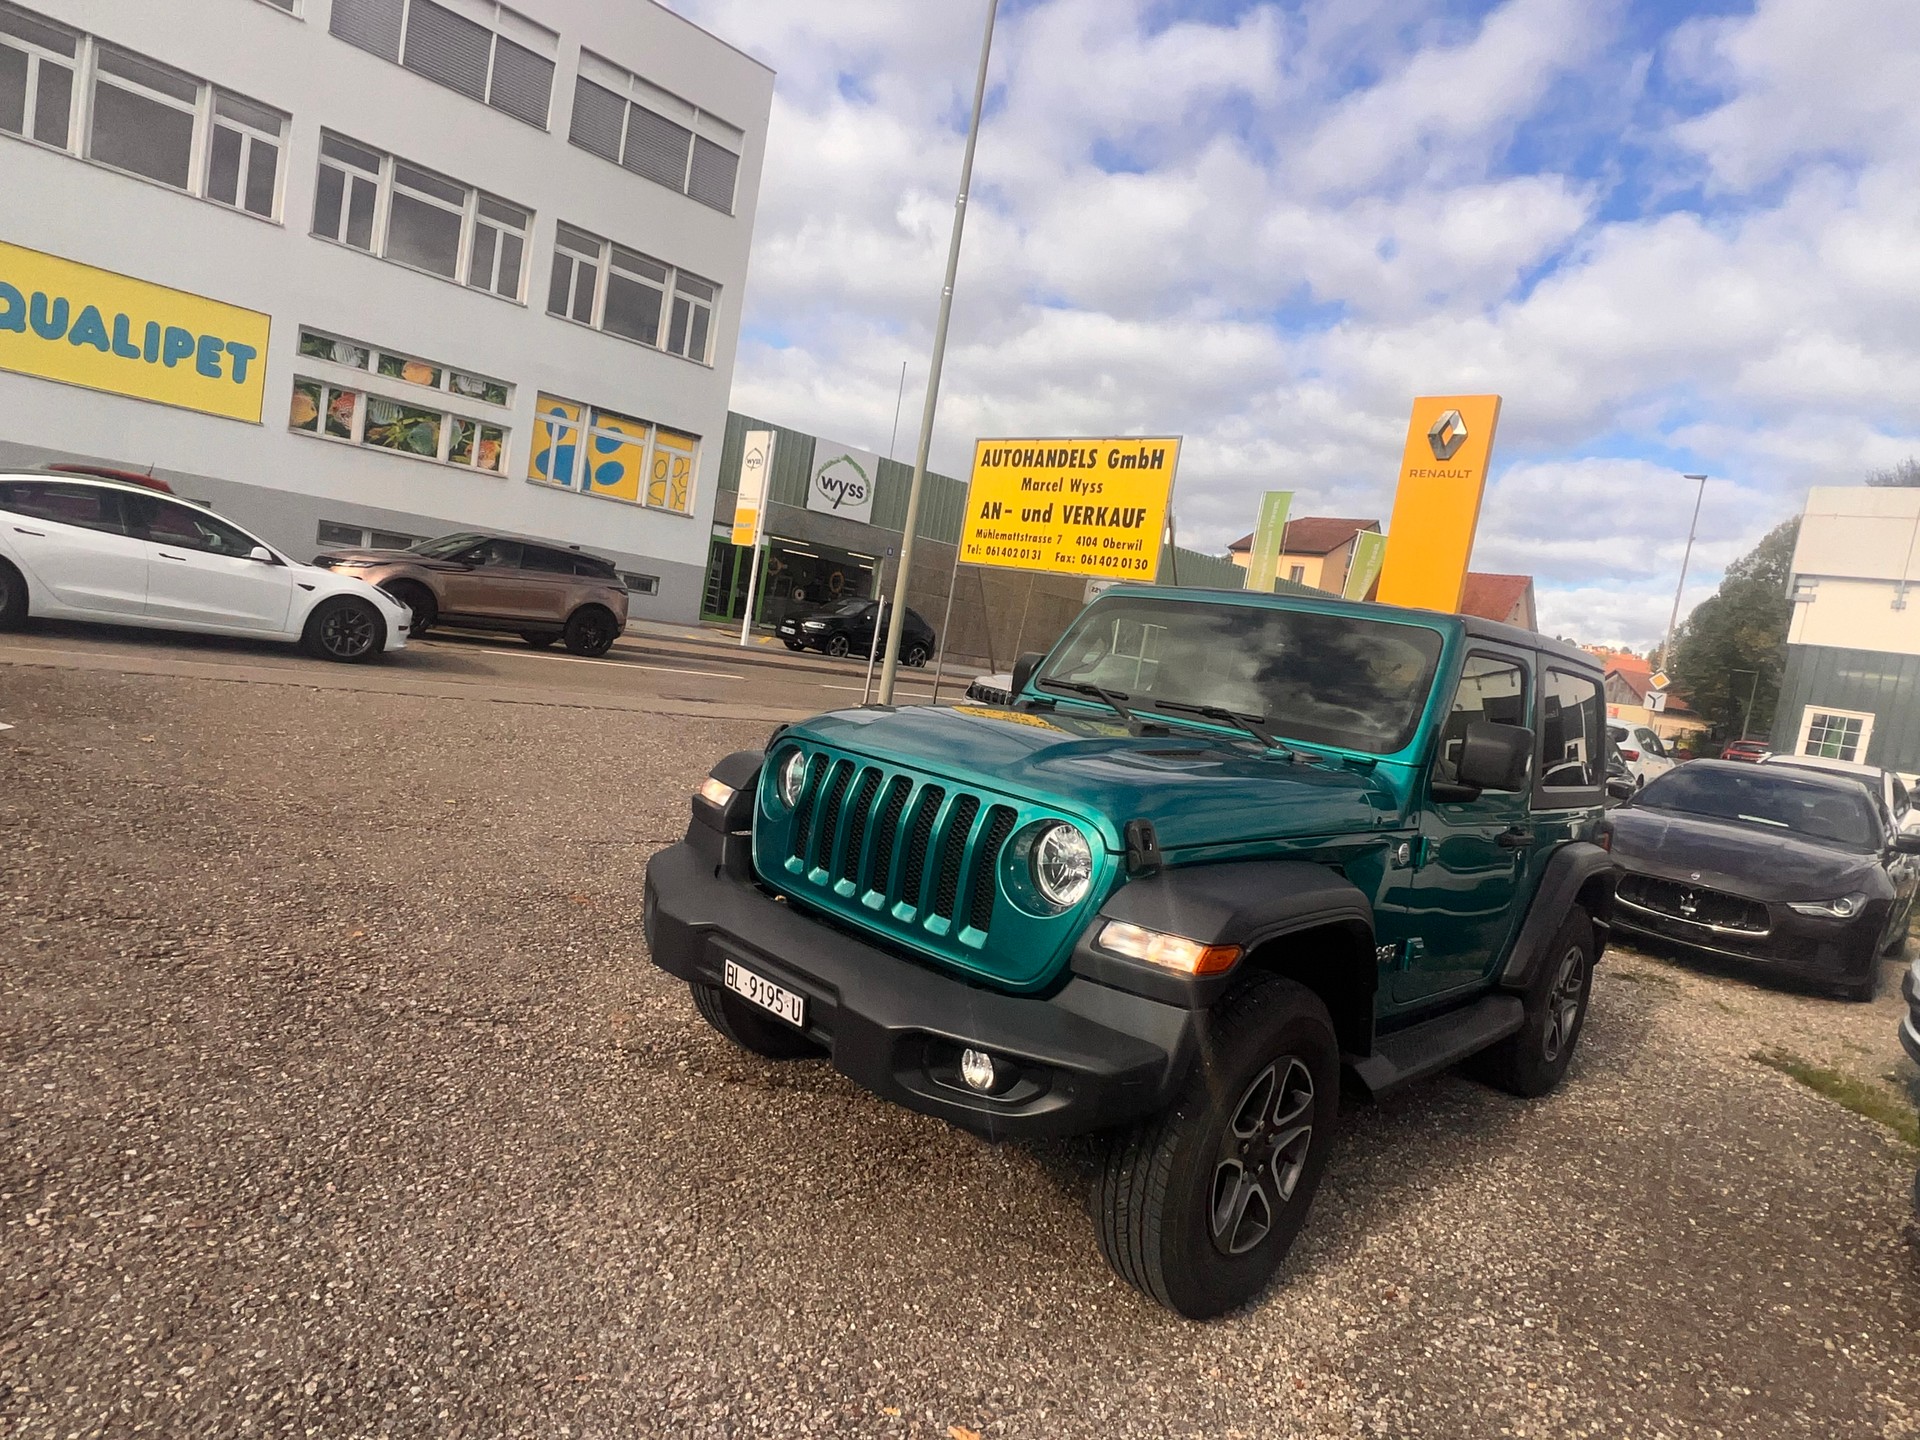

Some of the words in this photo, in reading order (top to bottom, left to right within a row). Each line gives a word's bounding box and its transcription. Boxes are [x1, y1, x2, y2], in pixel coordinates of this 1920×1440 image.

[0, 281, 257, 384] QUALIPET
[981, 448, 1098, 469] AUTOHANDELS
[1107, 447, 1165, 470] GmbH
[1409, 469, 1472, 479] RENAULT
[821, 475, 864, 510] wyss
[1021, 477, 1064, 493] Marcel
[1070, 478, 1103, 496] Wyss
[1021, 502, 1053, 523] und
[1063, 504, 1147, 529] VERKAUF
[976, 528, 1052, 544] Mühlemattstrasse
[1057, 534, 1063, 545] 7
[1076, 535, 1098, 547] 4104
[1103, 537, 1143, 551] Oberwil
[967, 544, 982, 555] Tel:
[1055, 552, 1076, 564] Fax:
